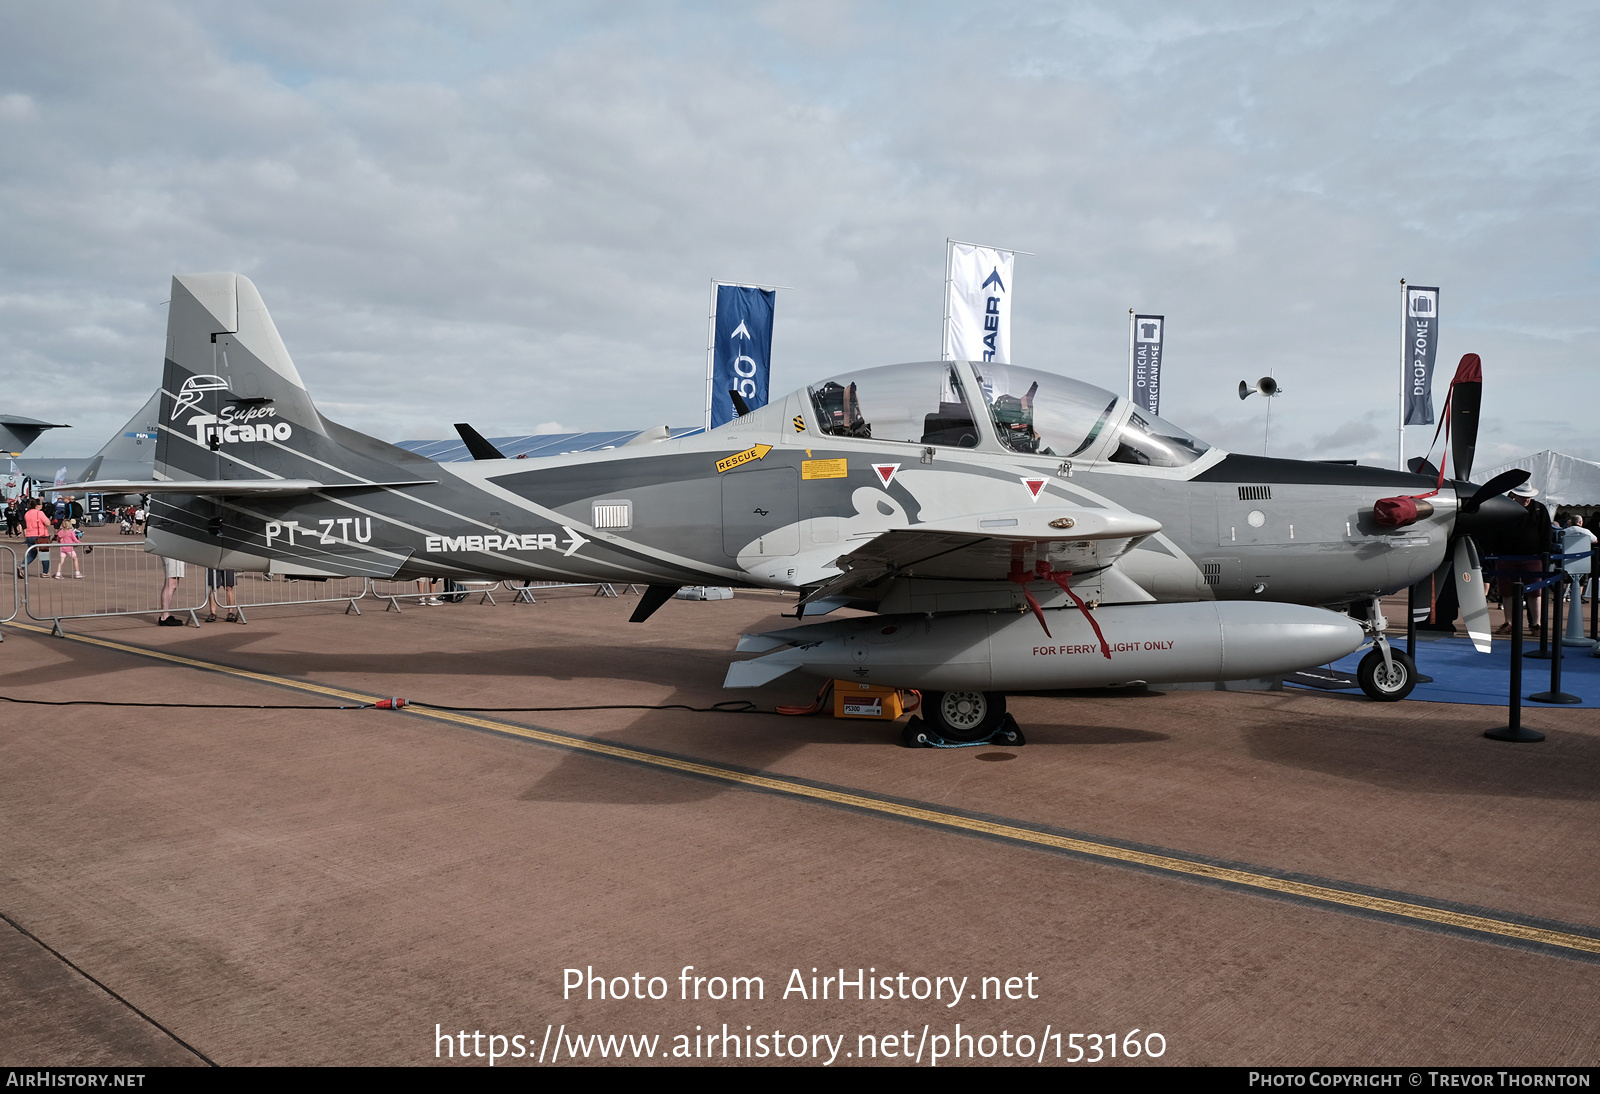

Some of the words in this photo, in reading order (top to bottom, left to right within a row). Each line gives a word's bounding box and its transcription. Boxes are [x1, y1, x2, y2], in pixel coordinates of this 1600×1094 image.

[1415, 320, 1428, 356] ZONE
[733, 355, 757, 399] 50
[1136, 344, 1147, 388] OFFICIAL
[1149, 345, 1160, 415] MERCHANDISE
[1413, 359, 1426, 396] DROP
[186, 414, 293, 446] Tucano
[218, 405, 277, 425] Super
[718, 449, 757, 470] RESCUE
[265, 517, 372, 548] PT-ZTU
[425, 533, 557, 553] EMBRAER
[1032, 646, 1057, 656] FOR
[1059, 644, 1097, 655] FERRY
[1143, 640, 1175, 651] ONLY
